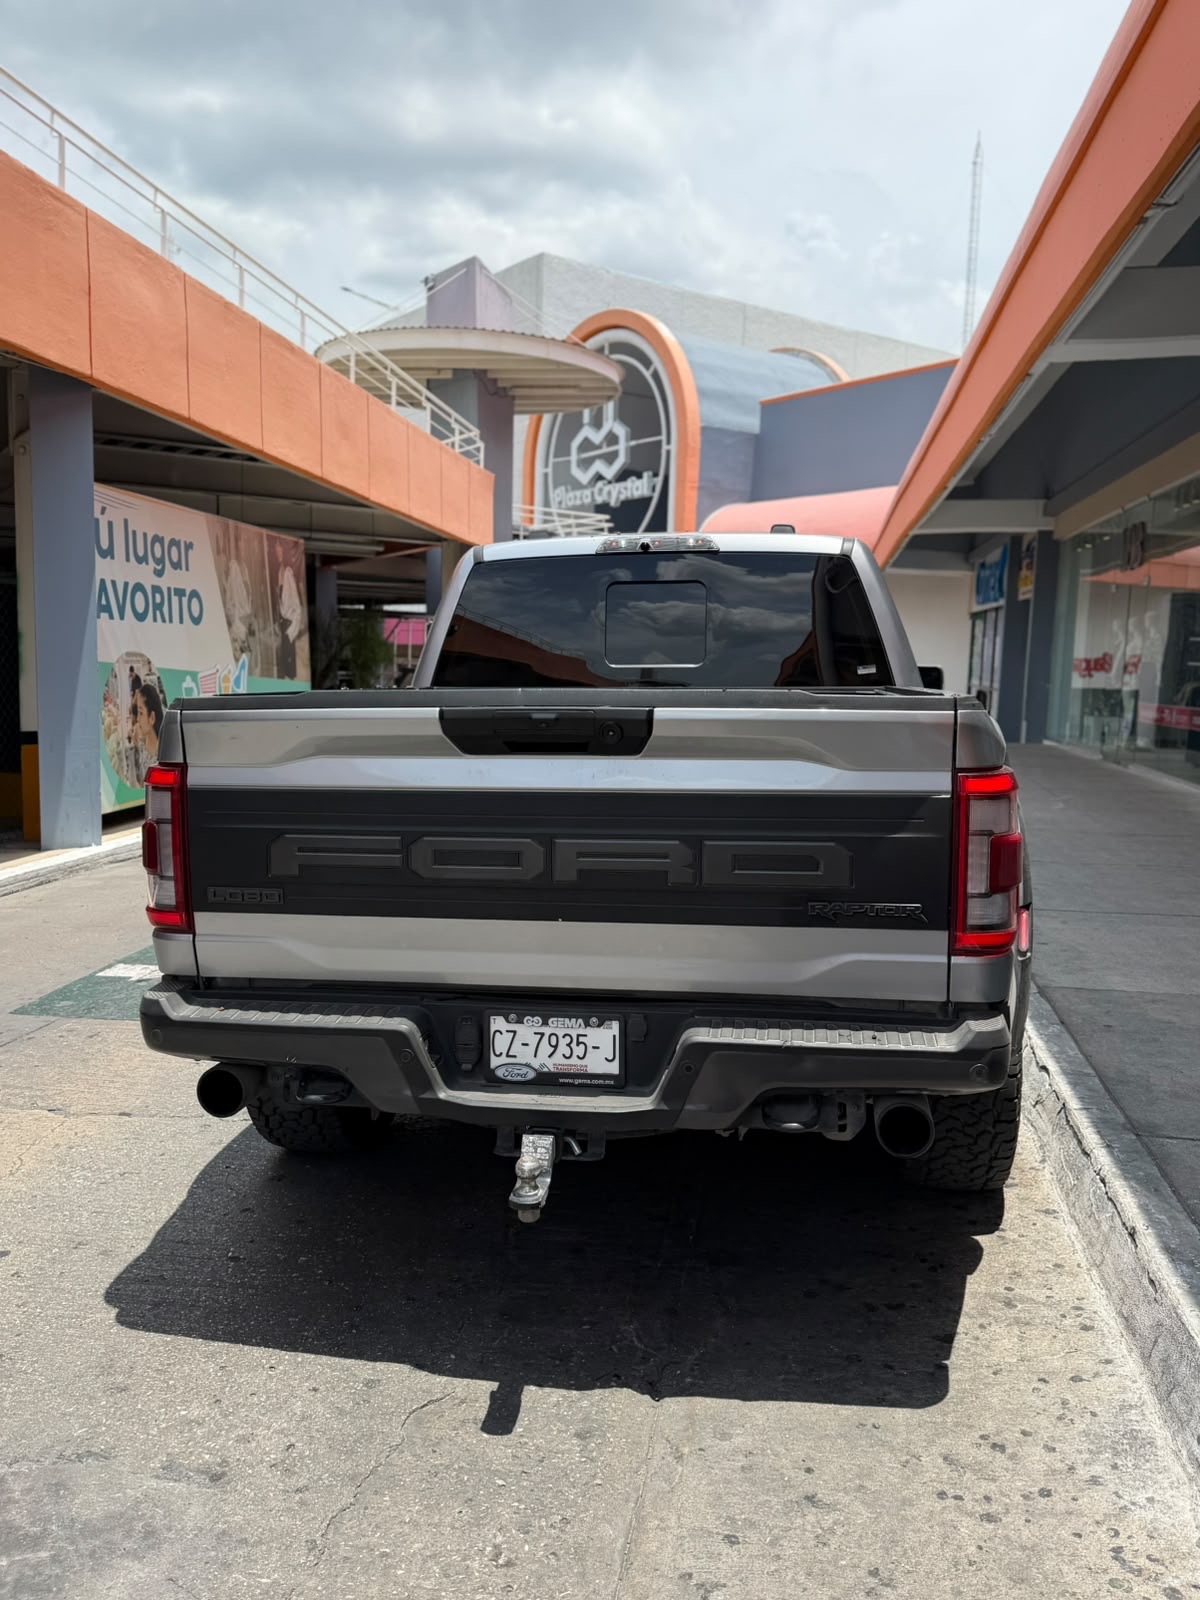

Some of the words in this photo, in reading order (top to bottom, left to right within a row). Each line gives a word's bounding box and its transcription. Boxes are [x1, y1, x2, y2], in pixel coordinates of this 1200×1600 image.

[554, 485, 593, 508] Plaza
[594, 471, 653, 507] Crystal
[95, 505, 115, 561] ú
[123, 517, 194, 578] lugar
[97, 577, 204, 626] AVORITO
[267, 834, 855, 888] FORD
[207, 886, 284, 904] LOBO
[807, 902, 928, 922] RAPTOR
[548, 1017, 586, 1029] GEMA
[491, 1029, 617, 1062] CZ-7935-J
[502, 1068, 529, 1079] Ford
